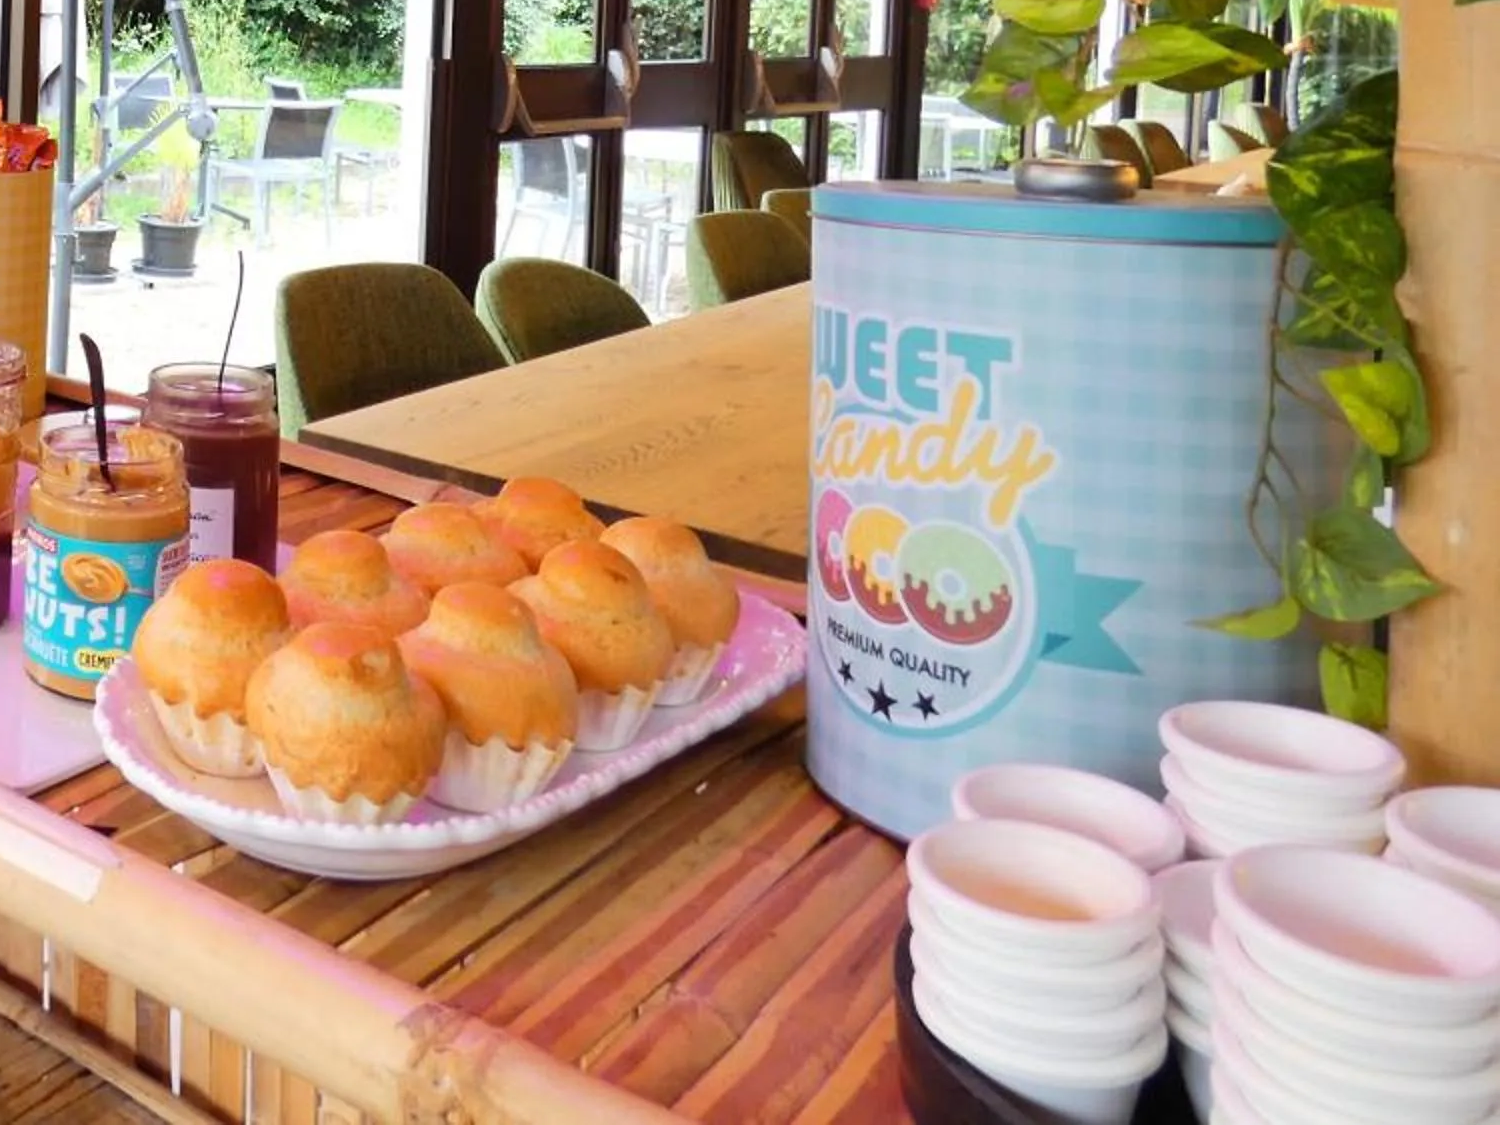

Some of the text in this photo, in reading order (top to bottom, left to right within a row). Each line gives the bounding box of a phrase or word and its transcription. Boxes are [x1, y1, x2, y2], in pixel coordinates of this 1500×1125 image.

[816, 307, 1012, 420] WEET
[24, 585, 128, 647] NUTS!
[828, 616, 971, 687] PREMIUM QUALITY
